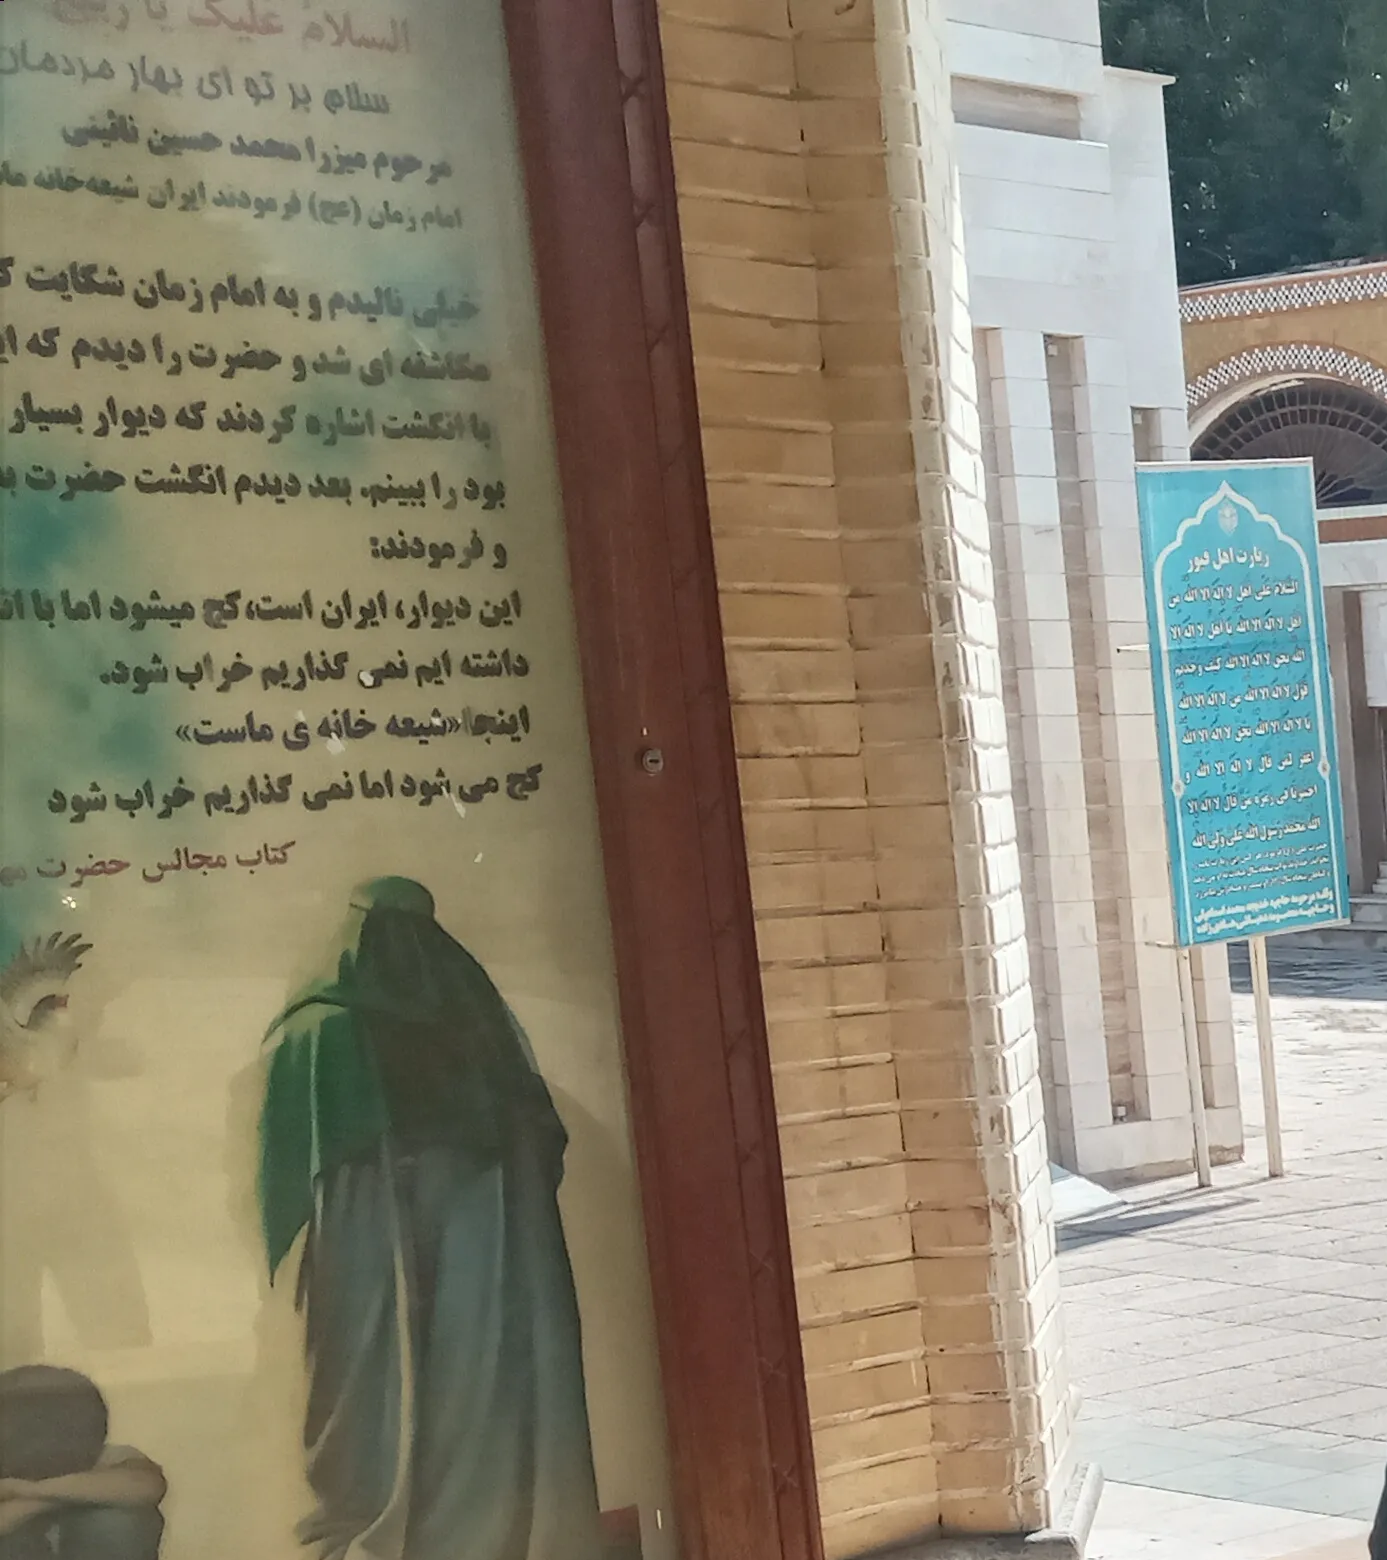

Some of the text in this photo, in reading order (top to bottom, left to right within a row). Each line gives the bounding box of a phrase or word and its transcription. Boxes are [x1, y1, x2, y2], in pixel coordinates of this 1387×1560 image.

[128, 55, 183, 96] بهار
[196, 65, 234, 101] ای
[244, 71, 275, 107] تو
[288, 82, 312, 113] بر
[323, 82, 392, 115] سلام
[146, 128, 223, 156] حسین
[230, 134, 302, 162] محمد
[146, 178, 207, 212] ایران
[212, 190, 302, 221] فرمودند
[367, 200, 417, 233] زمان
[421, 205, 464, 232] امام
[25, 261, 125, 302] شکایت
[132, 268, 204, 313] زمان
[209, 274, 266, 314] امام
[273, 285, 299, 317] به
[307, 293, 322, 322] و
[327, 286, 404, 323] نالیدم
[25, 326, 492, 387] مکاشفه ای شد و حضرت را دیدم که
[8, 391, 84, 434] بسیار
[93, 395, 167, 438] دیوار
[175, 401, 207, 431] که
[216, 401, 297, 444] کردند
[306, 406, 375, 447] اشاره
[471, 413, 492, 449] با
[25, 461, 126, 501] حضرت
[234, 472, 302, 505] دیدم
[308, 473, 352, 506] بعد
[430, 471, 458, 510] را
[463, 477, 506, 511] بود
[492, 543, 508, 569] و
[30, 589, 55, 629] با
[60, 589, 102, 621] اما
[109, 590, 195, 632] میشود
[321, 589, 387, 630] ایران
[479, 589, 523, 628] این
[175, 652, 253, 693] خراب
[357, 649, 409, 689] نمی
[415, 649, 452, 688] ایم
[460, 648, 530, 678] داشته
[282, 722, 311, 751] ی
[316, 708, 377, 740] خانه
[463, 704, 530, 745] اینجا
[114, 776, 195, 819] خراب
[302, 771, 354, 811] نمی
[359, 769, 394, 799] اما
[400, 767, 451, 807] شود
[458, 776, 499, 804] می
[506, 763, 543, 801] کج
[47, 781, 107, 823] شود
[36, 853, 131, 888] حضرت
[142, 846, 227, 884] مجالس
[235, 840, 297, 875] کتاب
